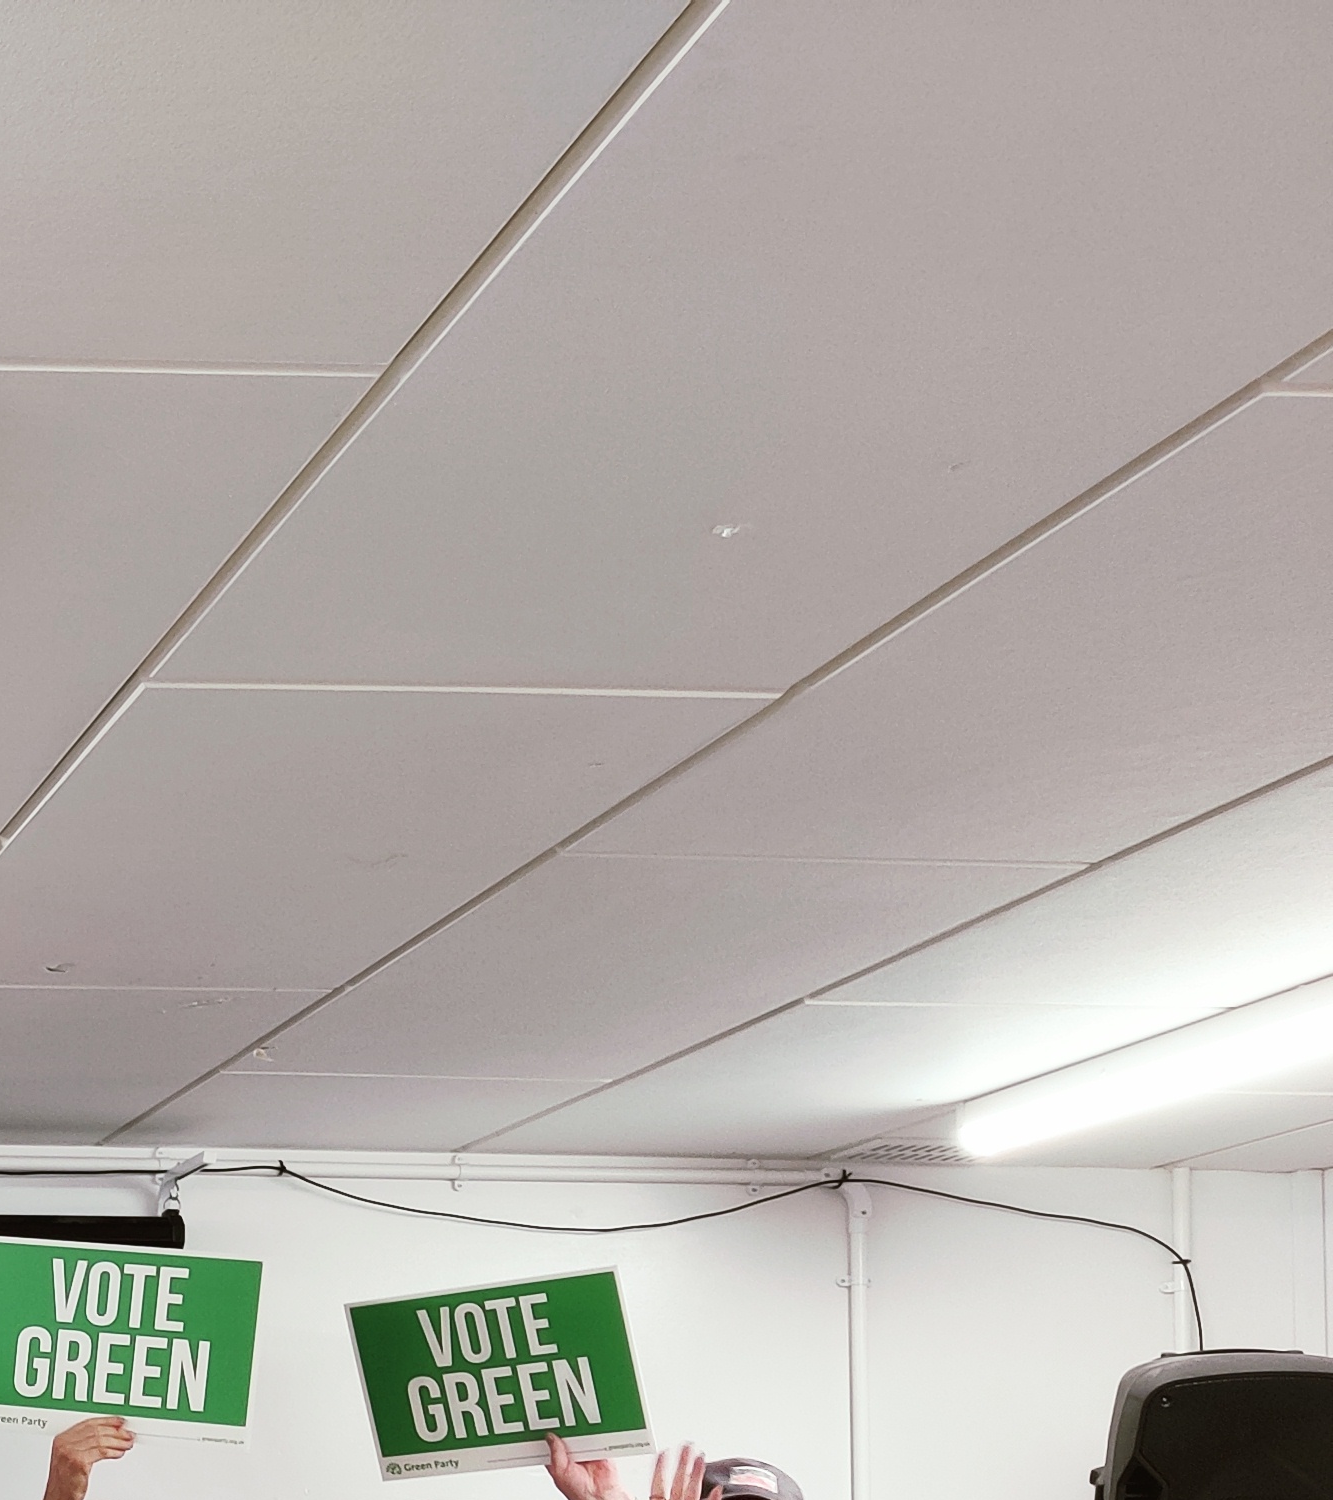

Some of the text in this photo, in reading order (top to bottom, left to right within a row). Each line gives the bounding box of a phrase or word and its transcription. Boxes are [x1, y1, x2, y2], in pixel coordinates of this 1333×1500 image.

[52, 1258, 190, 1332] VOTE
[416, 1292, 558, 1367] VOTE
[13, 1325, 211, 1412] GREEN
[407, 1356, 602, 1442] GREEN
[21, 1416, 48, 1429] Party
[403, 1460, 459, 1471] Green Party
